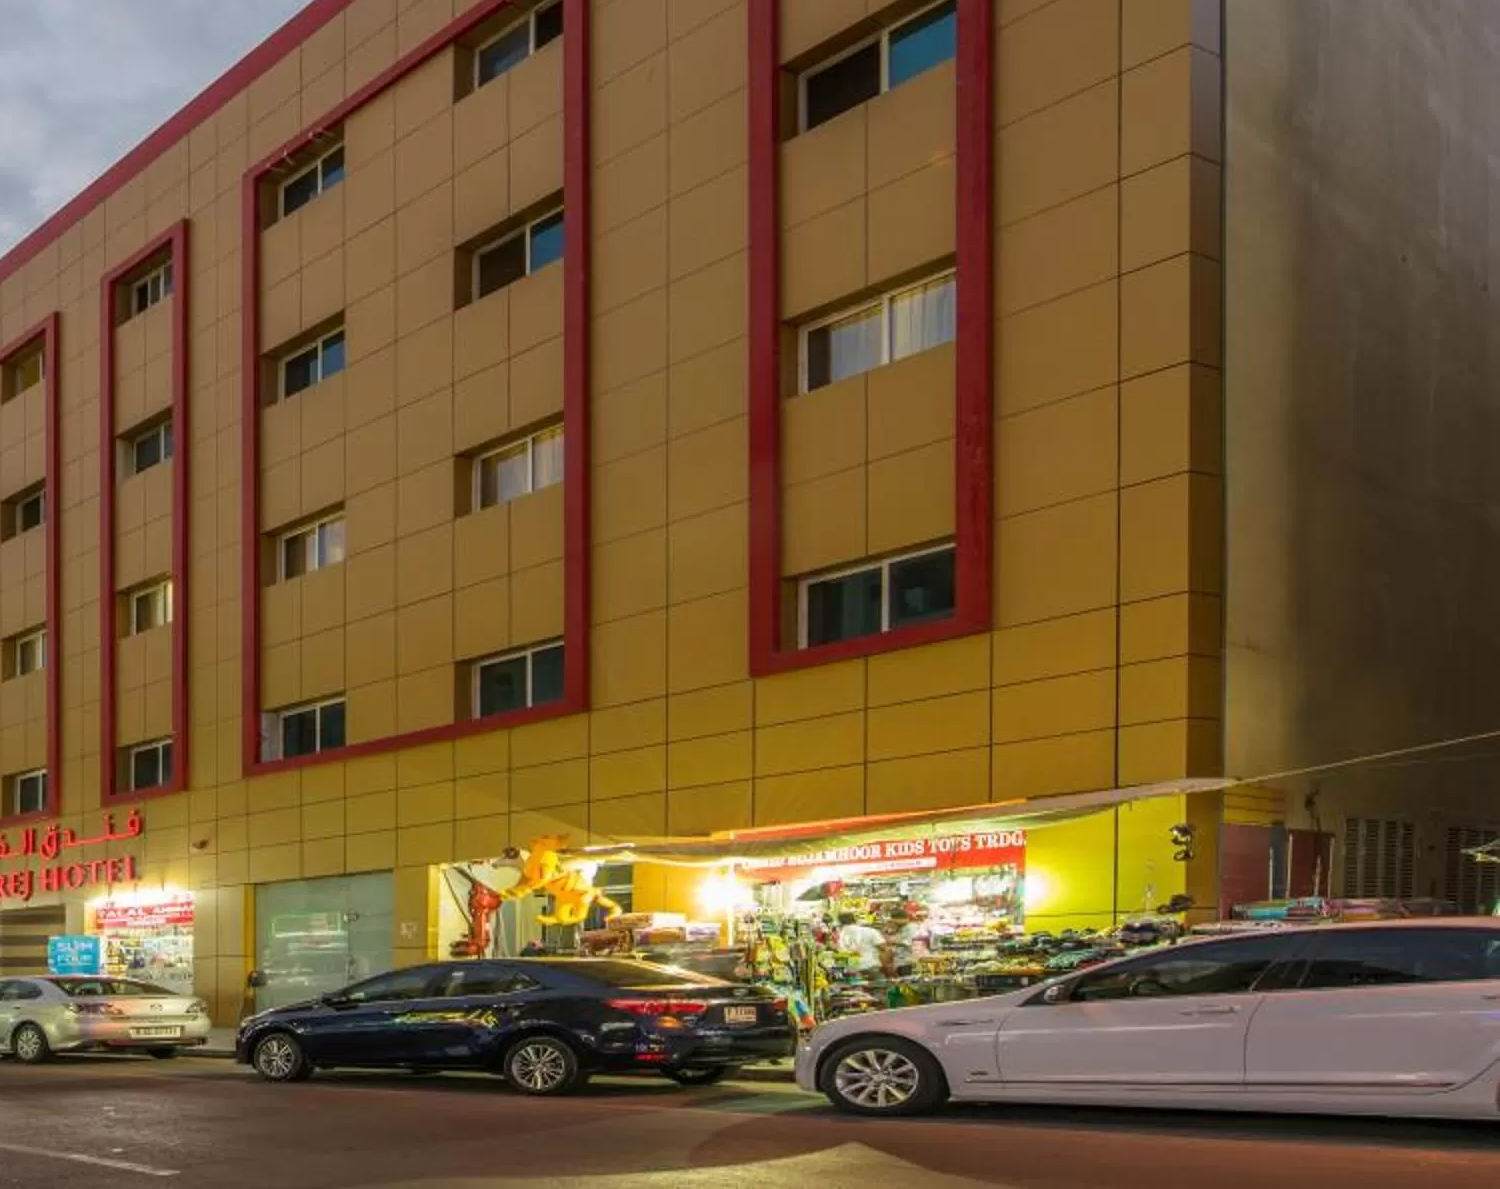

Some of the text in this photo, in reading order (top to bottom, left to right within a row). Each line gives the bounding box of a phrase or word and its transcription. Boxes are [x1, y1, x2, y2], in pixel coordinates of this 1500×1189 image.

[40, 809, 144, 860] فندق
[886, 840, 924, 859] KIDS
[928, 834, 971, 853] TOYS
[39, 854, 139, 893] HOTEL
